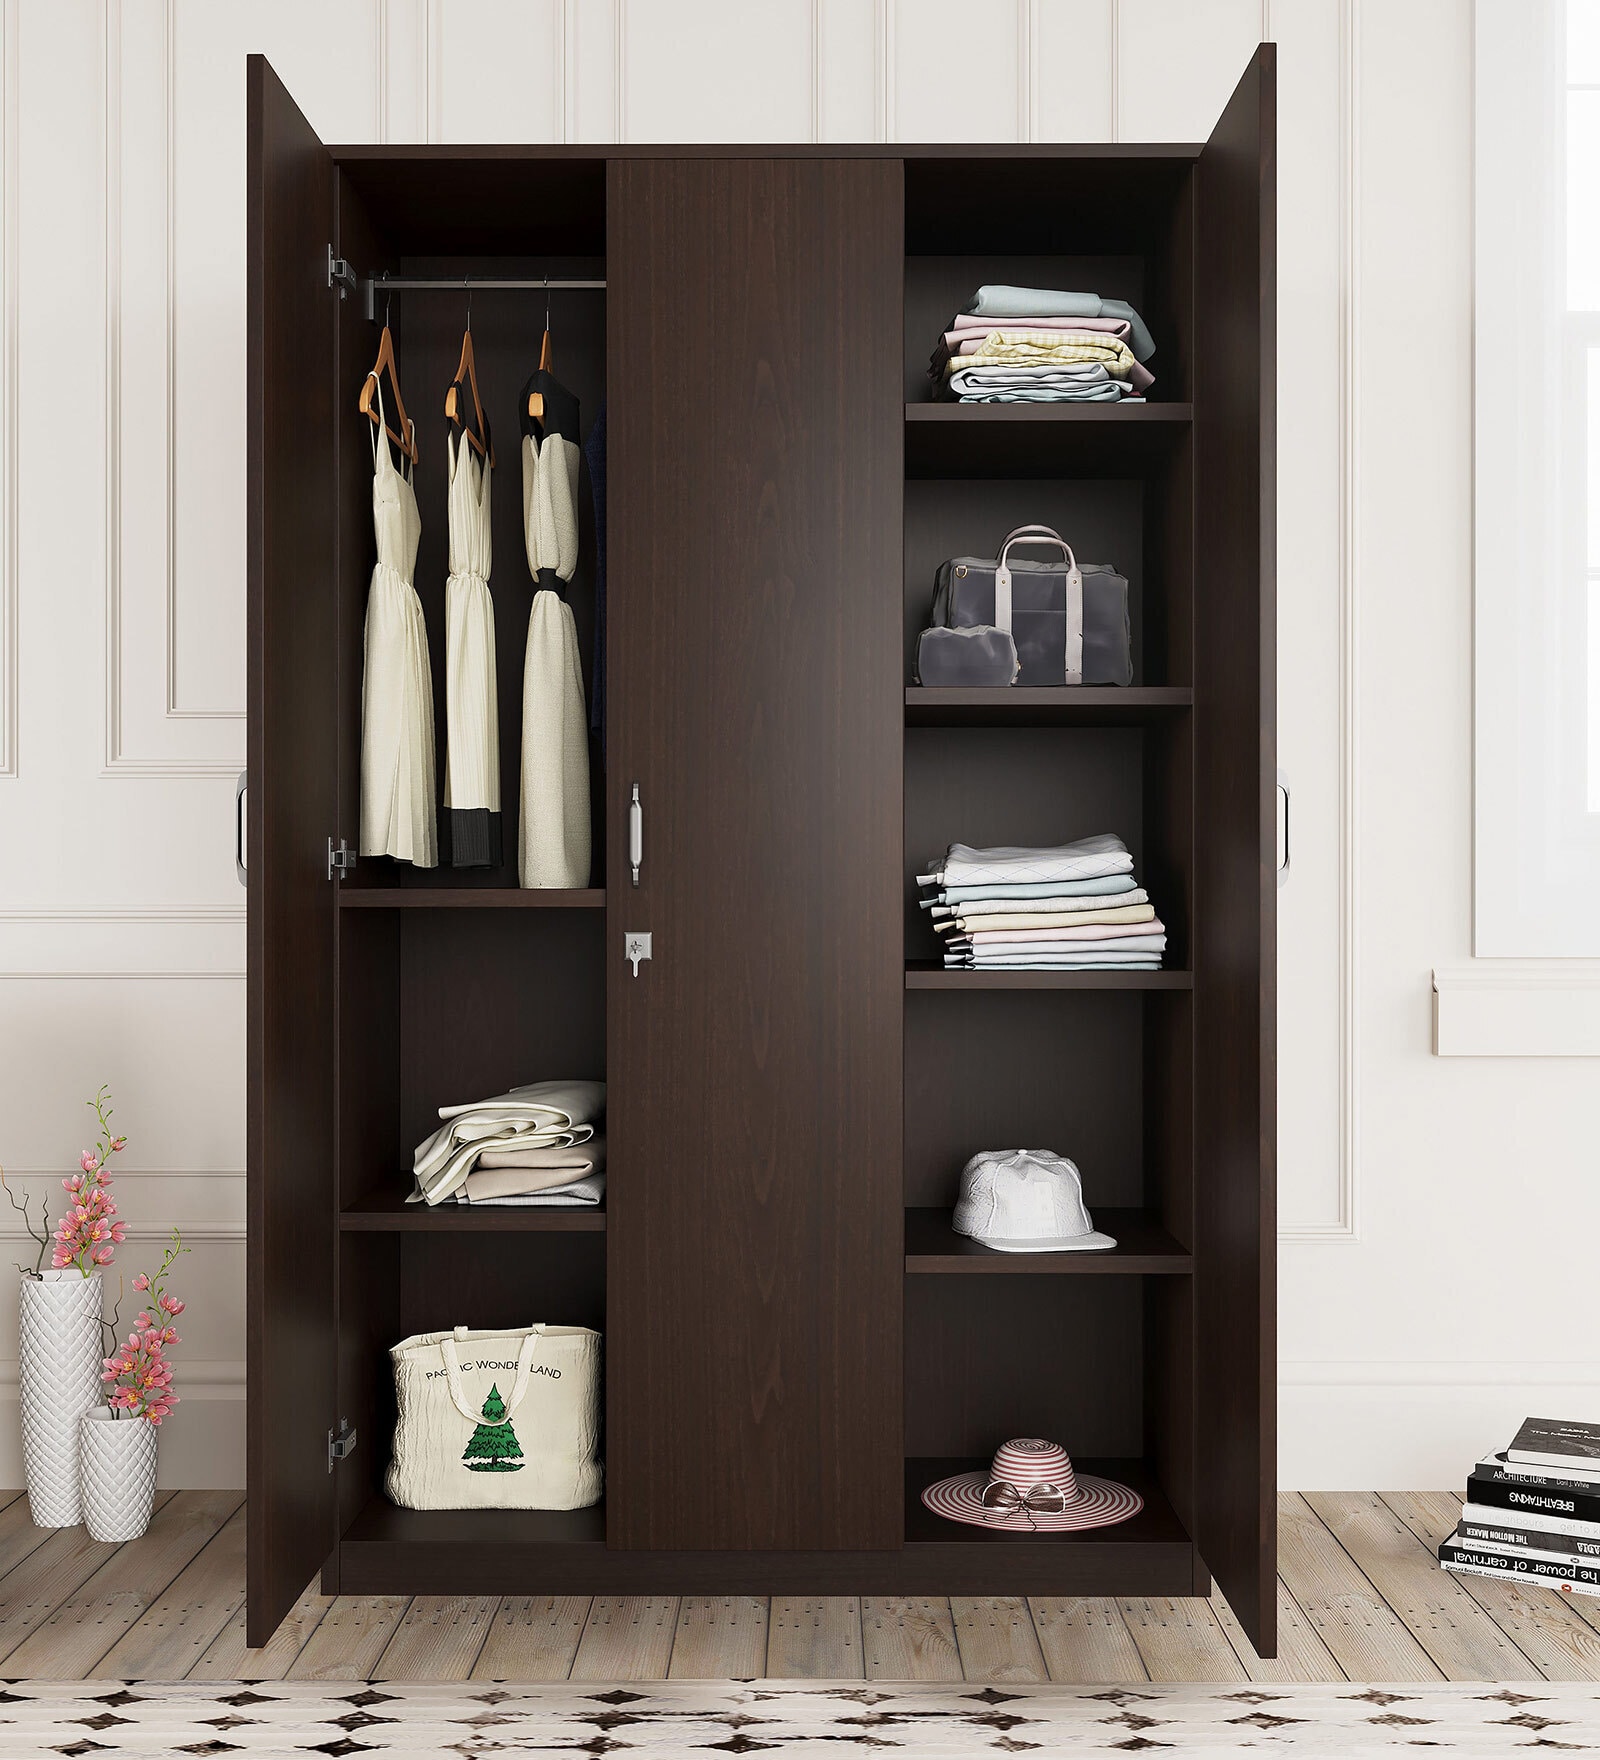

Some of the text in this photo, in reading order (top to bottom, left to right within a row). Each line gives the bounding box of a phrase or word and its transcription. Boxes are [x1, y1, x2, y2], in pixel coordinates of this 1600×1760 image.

[425, 1360, 562, 1380] PACIC WONDELAND
[1492, 1470, 1548, 1486] ARCHITECTURE
[1508, 1491, 1575, 1512] BREATHTAKING
[1466, 1527, 1489, 1540] MAKER
[1453, 1551, 1508, 1568] carnival
[1512, 1560, 1528, 1572] of
[1532, 1563, 1577, 1579] power
